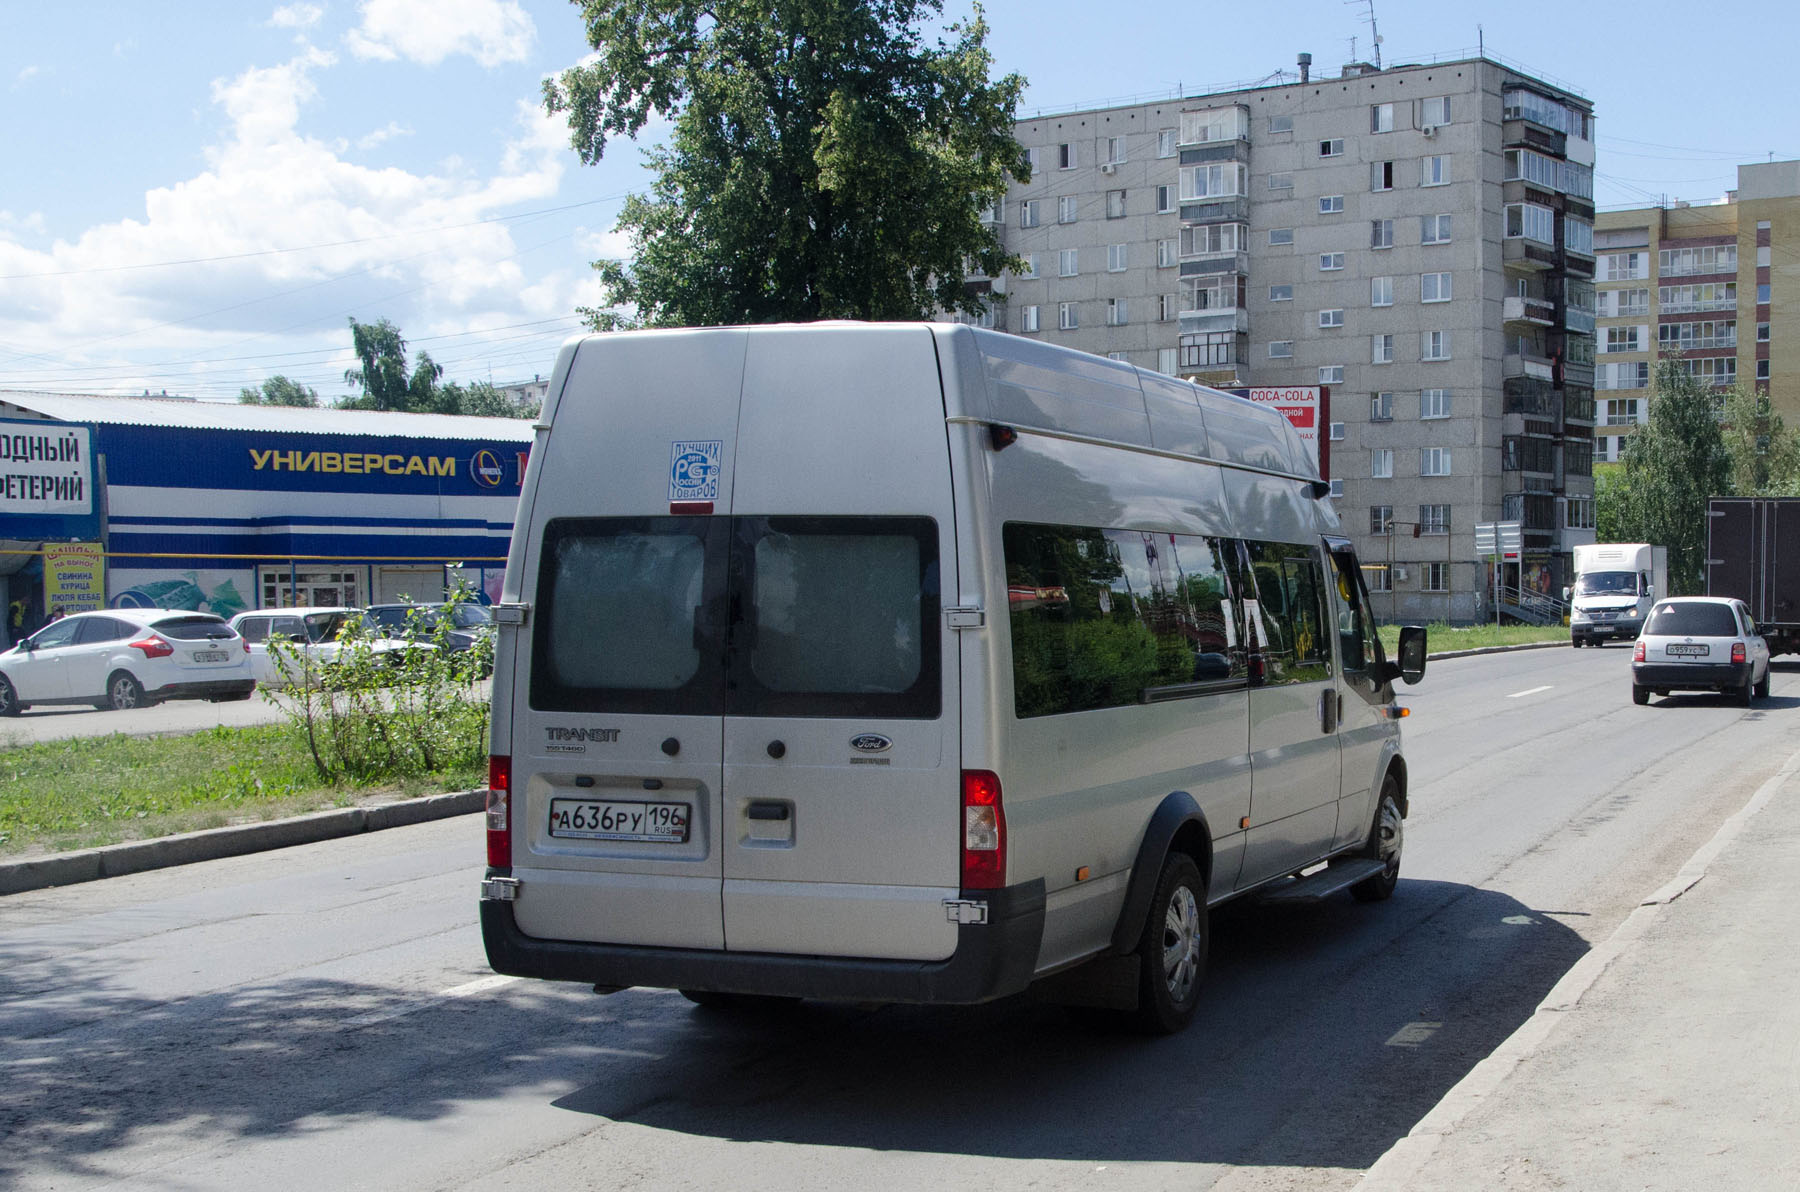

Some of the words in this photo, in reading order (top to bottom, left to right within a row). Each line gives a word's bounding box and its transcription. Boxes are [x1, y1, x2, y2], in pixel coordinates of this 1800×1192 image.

[1251, 390, 1314, 401] COCA-COLA
[674, 443, 719, 461] ЛУЧШИХ
[249, 449, 456, 477] УНИВЕРСАМ
[0, 471, 83, 501] ЕТЕРИЙ
[672, 479, 717, 498] ТОВАРОВ
[57, 572, 93, 580] СВИНИНА
[61, 582, 90, 590] КУРИЦА
[77, 593, 101, 601] КЕБАБ
[545, 727, 621, 742] TRANSIT
[858, 737, 882, 748] Ford
[654, 826, 671, 834] RUS
